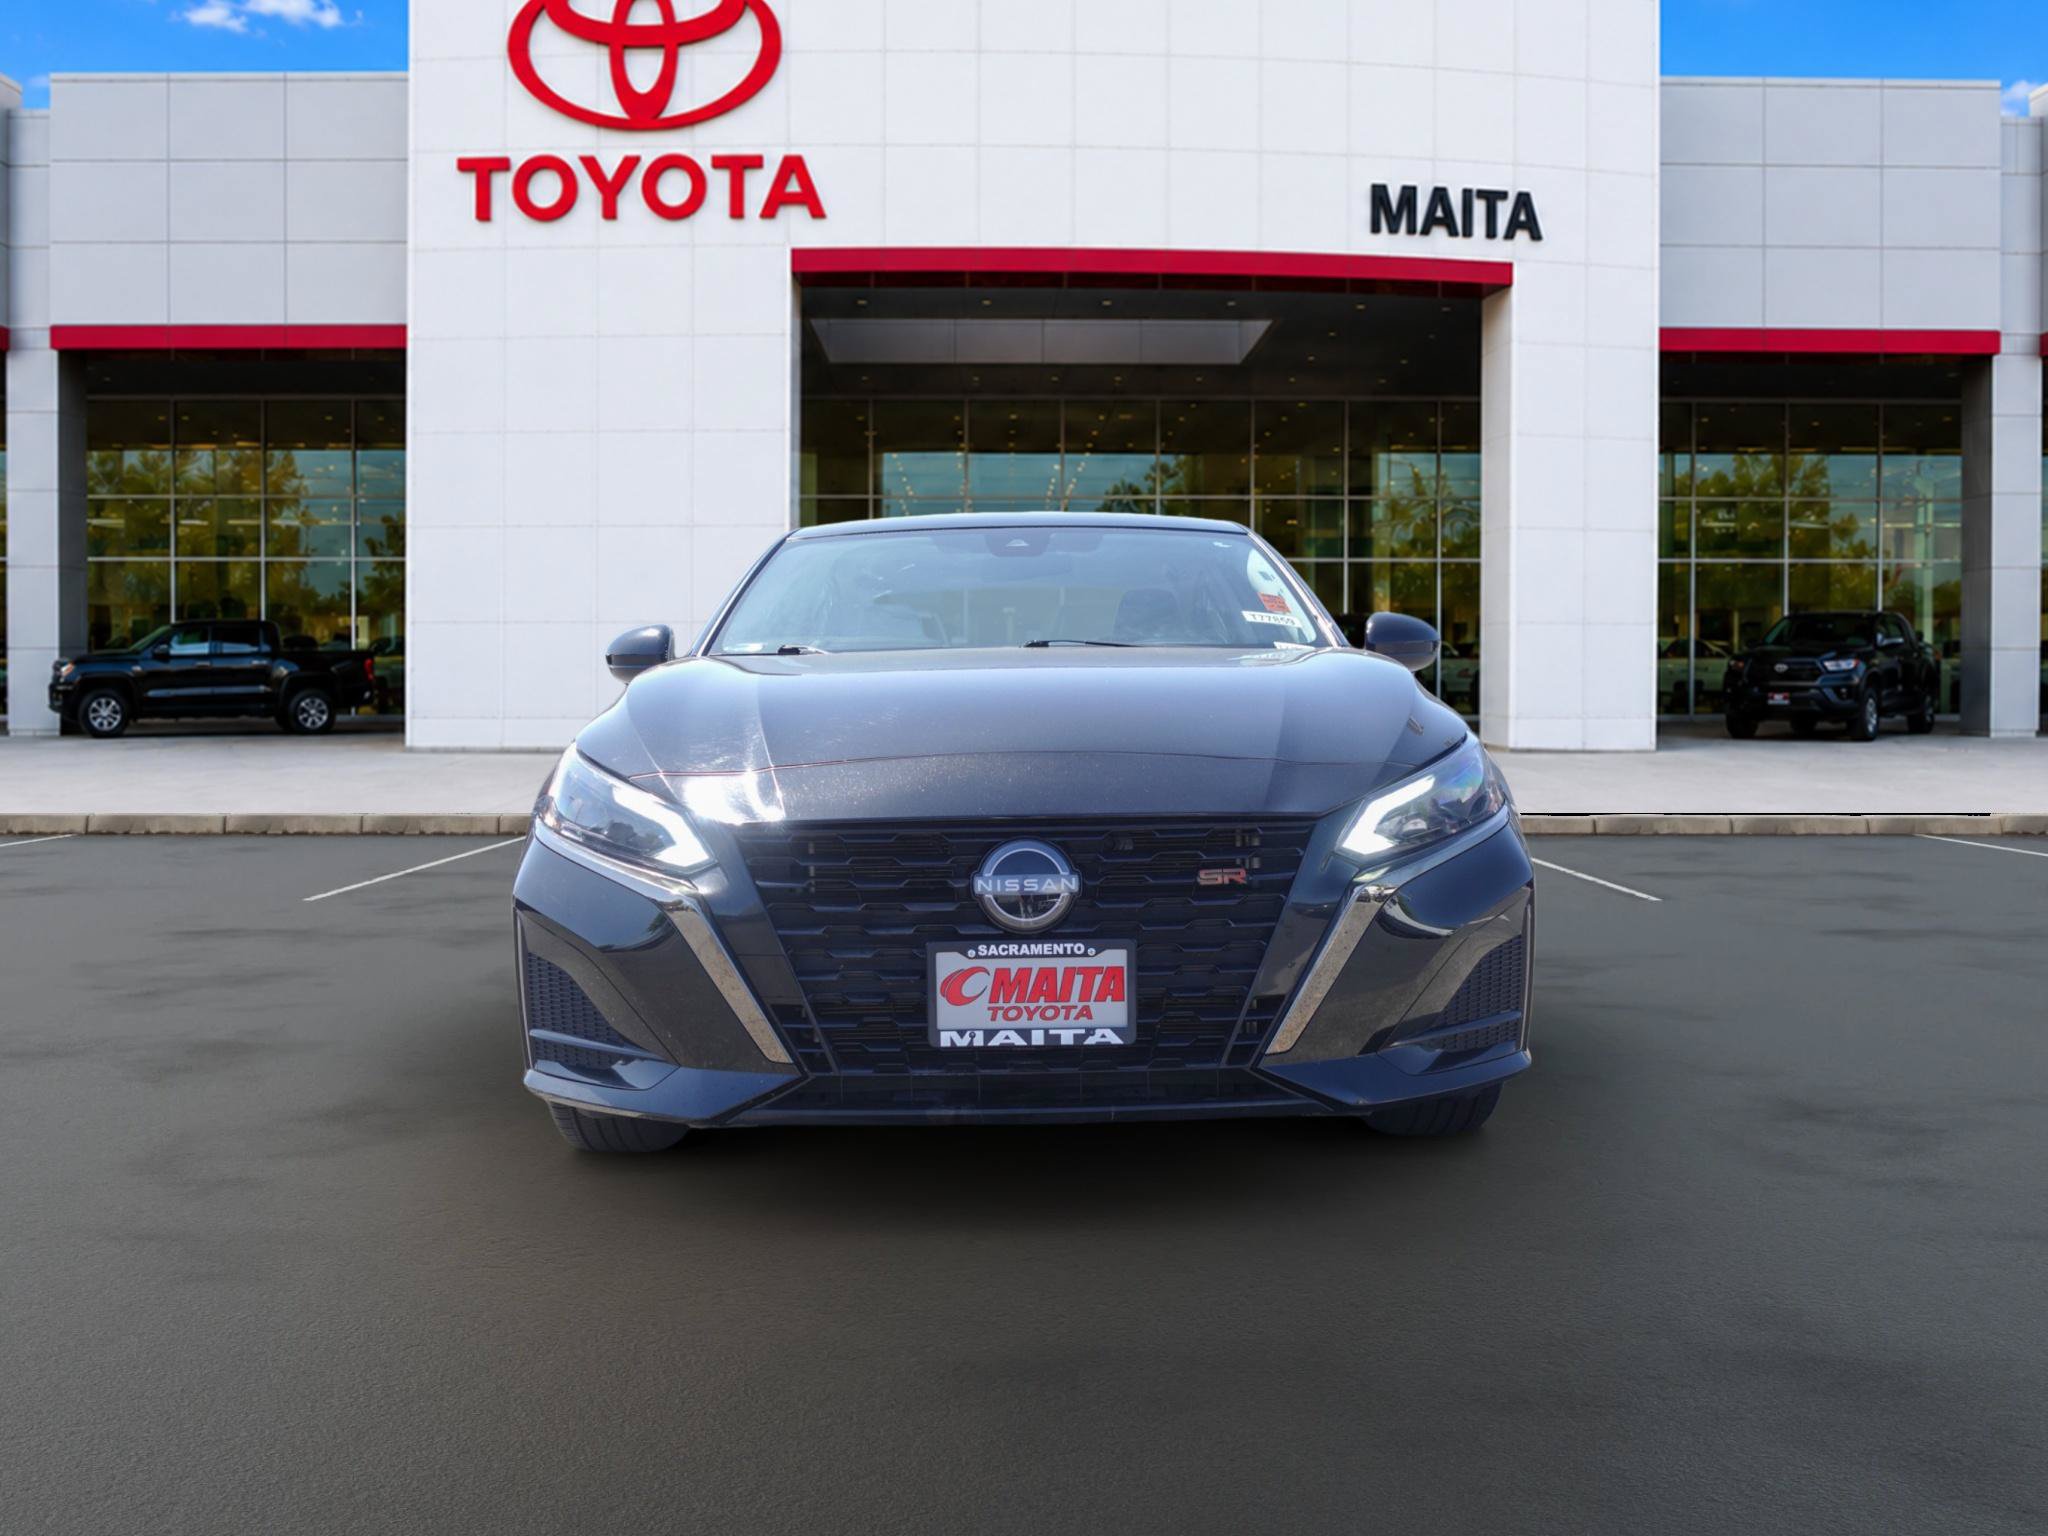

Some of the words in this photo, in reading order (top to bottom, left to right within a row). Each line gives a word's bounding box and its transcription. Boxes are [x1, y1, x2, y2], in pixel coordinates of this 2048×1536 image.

[456, 153, 827, 223] TOYOTA
[1370, 183, 1543, 242] MAITA
[977, 877, 1077, 892] NISSAN
[1197, 867, 1247, 886] SR
[977, 942, 1086, 957] SACRAMENTO
[988, 966, 1126, 1004] MAITA
[987, 1005, 1093, 1022] TOYOTA
[940, 1028, 1125, 1048] MAITA
